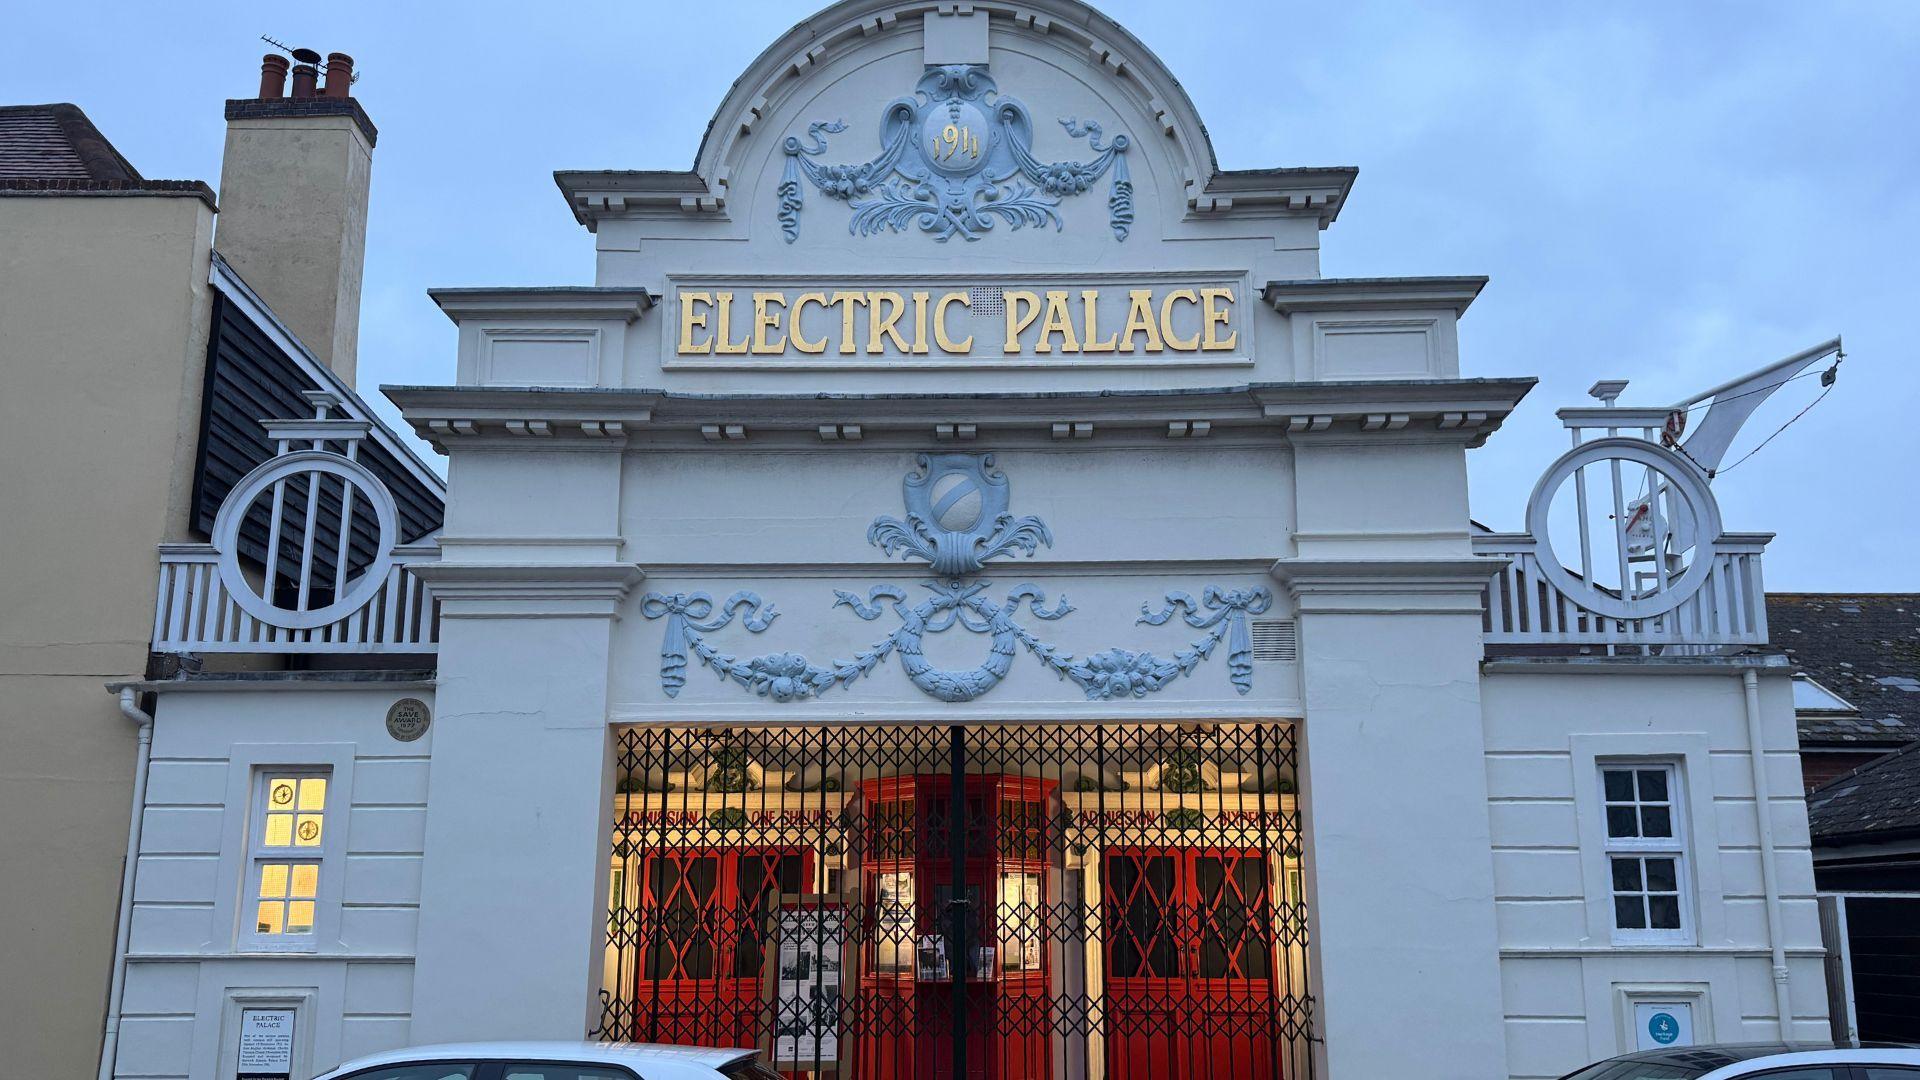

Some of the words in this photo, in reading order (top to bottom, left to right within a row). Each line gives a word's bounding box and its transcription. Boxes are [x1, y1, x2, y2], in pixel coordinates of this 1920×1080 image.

[932, 124, 978, 161] 1911
[678, 291, 973, 354] ELECTRIC
[1003, 289, 1237, 353] PALACE
[751, 810, 775, 826] ONE
[1080, 810, 1155, 826] ADMISSION
